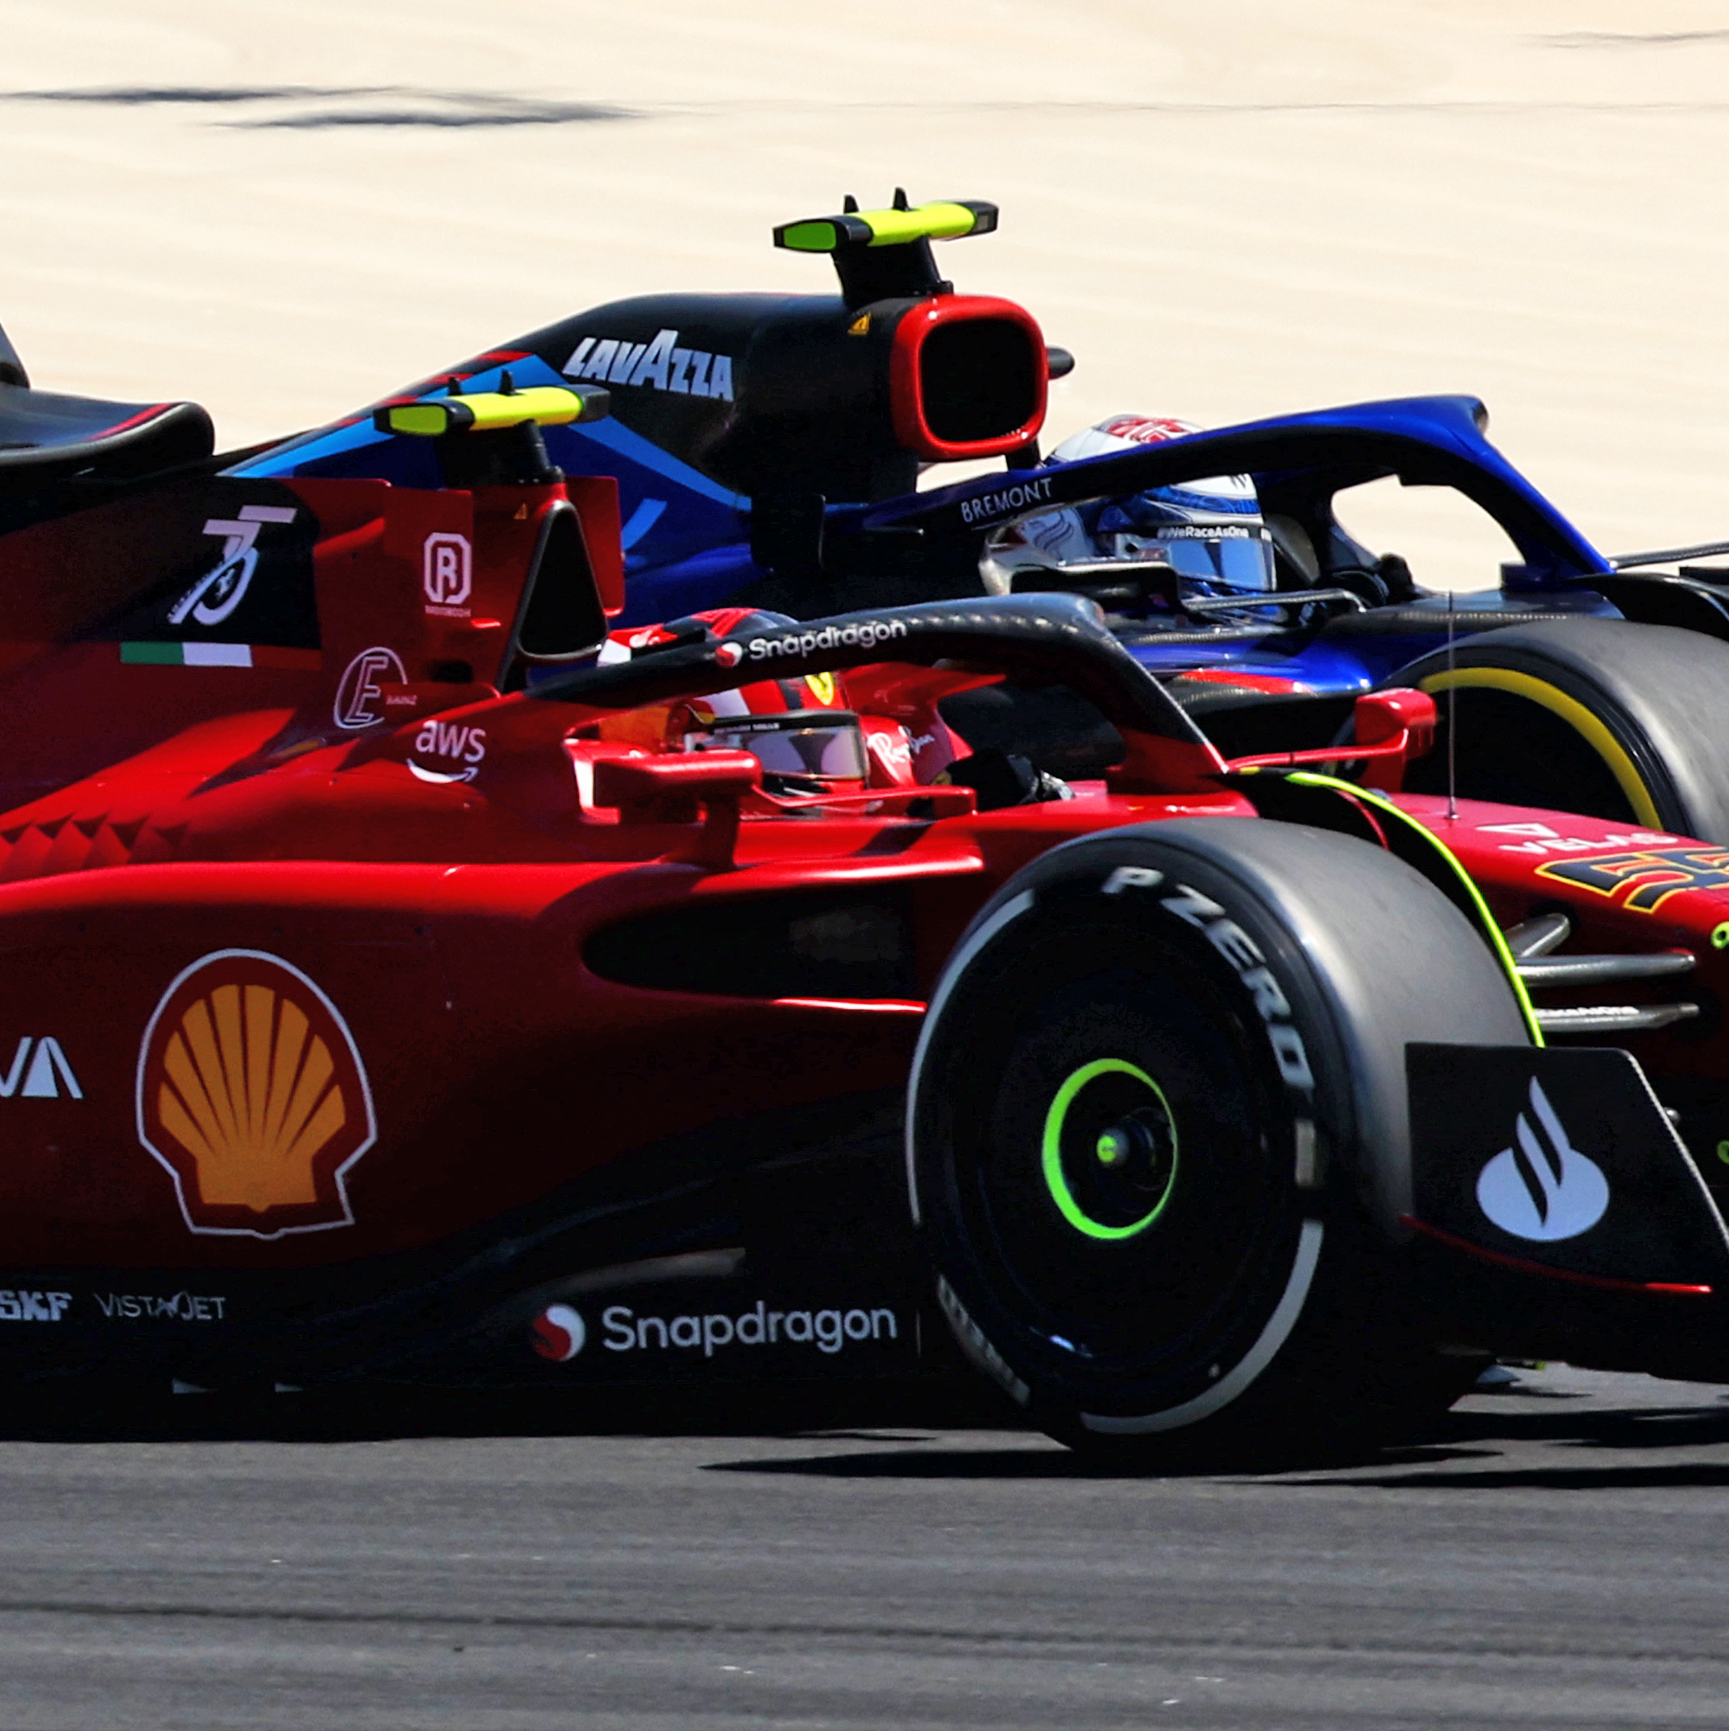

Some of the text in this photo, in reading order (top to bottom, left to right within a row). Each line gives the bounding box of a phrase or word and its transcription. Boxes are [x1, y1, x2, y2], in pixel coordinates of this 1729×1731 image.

[563, 329, 734, 403] LAVAZZA
[960, 477, 1055, 524] BREMONT
[749, 617, 907, 661] Snapdragon
[415, 719, 486, 763] aws
[1101, 866, 1315, 1090] P ZERO
[602, 1304, 898, 1357] Snapdragon
